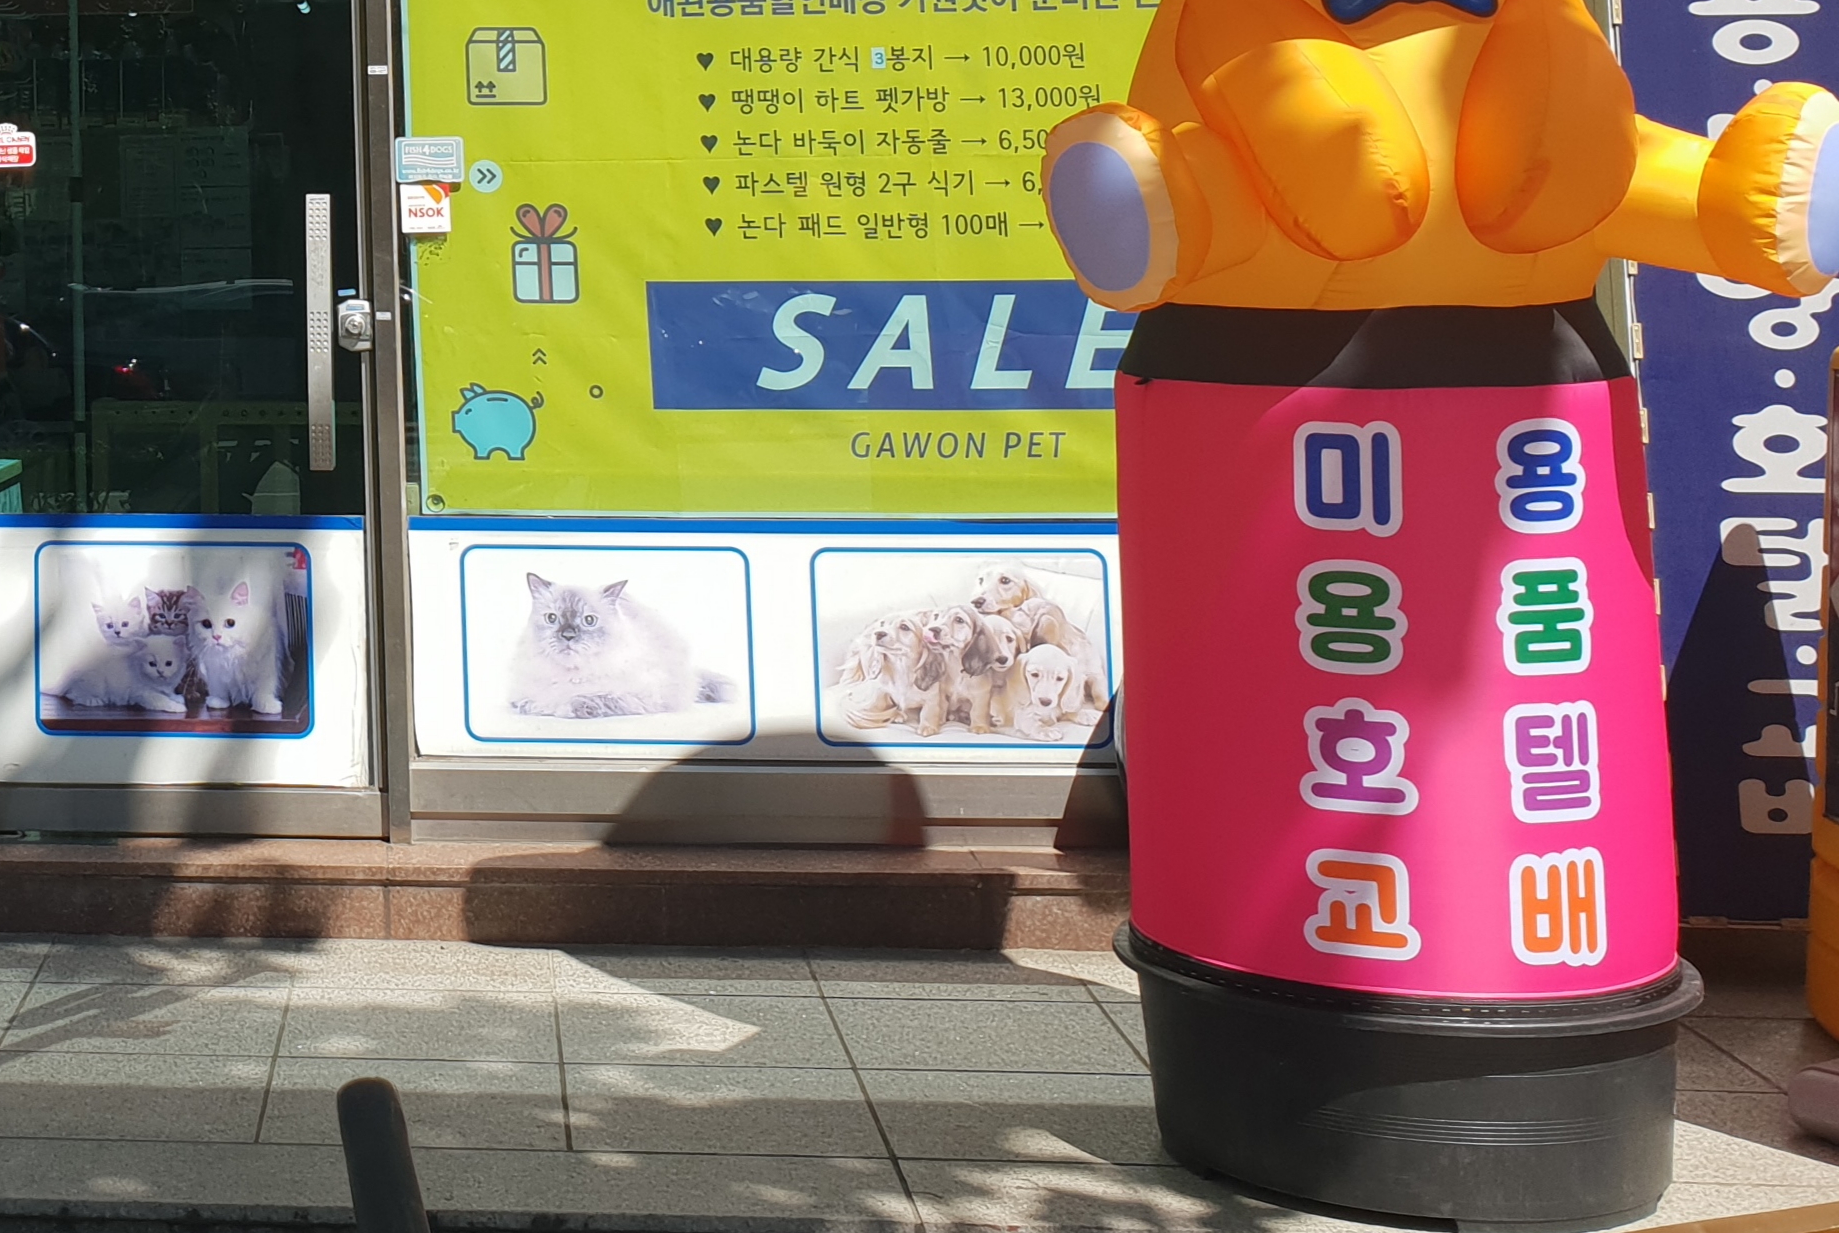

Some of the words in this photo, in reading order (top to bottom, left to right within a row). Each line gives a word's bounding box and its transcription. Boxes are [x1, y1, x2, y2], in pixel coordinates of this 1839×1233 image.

[730, 47, 803, 74] 대용량
[813, 46, 860, 73] 간식
[982, 42, 1086, 71] 10,000원
[731, 88, 804, 115] 땡땡이
[815, 87, 865, 114] 하트
[875, 86, 950, 113] 펫가방
[998, 84, 1101, 112] 13,000원
[733, 130, 783, 157] 논다
[793, 129, 865, 156] 바둑이
[876, 128, 951, 155] 자동줄
[735, 171, 809, 198] 파스텔
[820, 171, 867, 198] 원형
[878, 171, 917, 197] 2구
[927, 170, 974, 197] 식기
[408, 207, 445, 218] NSOK
[737, 213, 787, 240] 논다
[798, 212, 847, 239] 패드
[857, 212, 929, 240] 일반형
[941, 211, 1010, 238] 100매
[756, 292, 1138, 391] SALE
[850, 431, 987, 460] GAWON
[1003, 431, 1067, 459] PET
